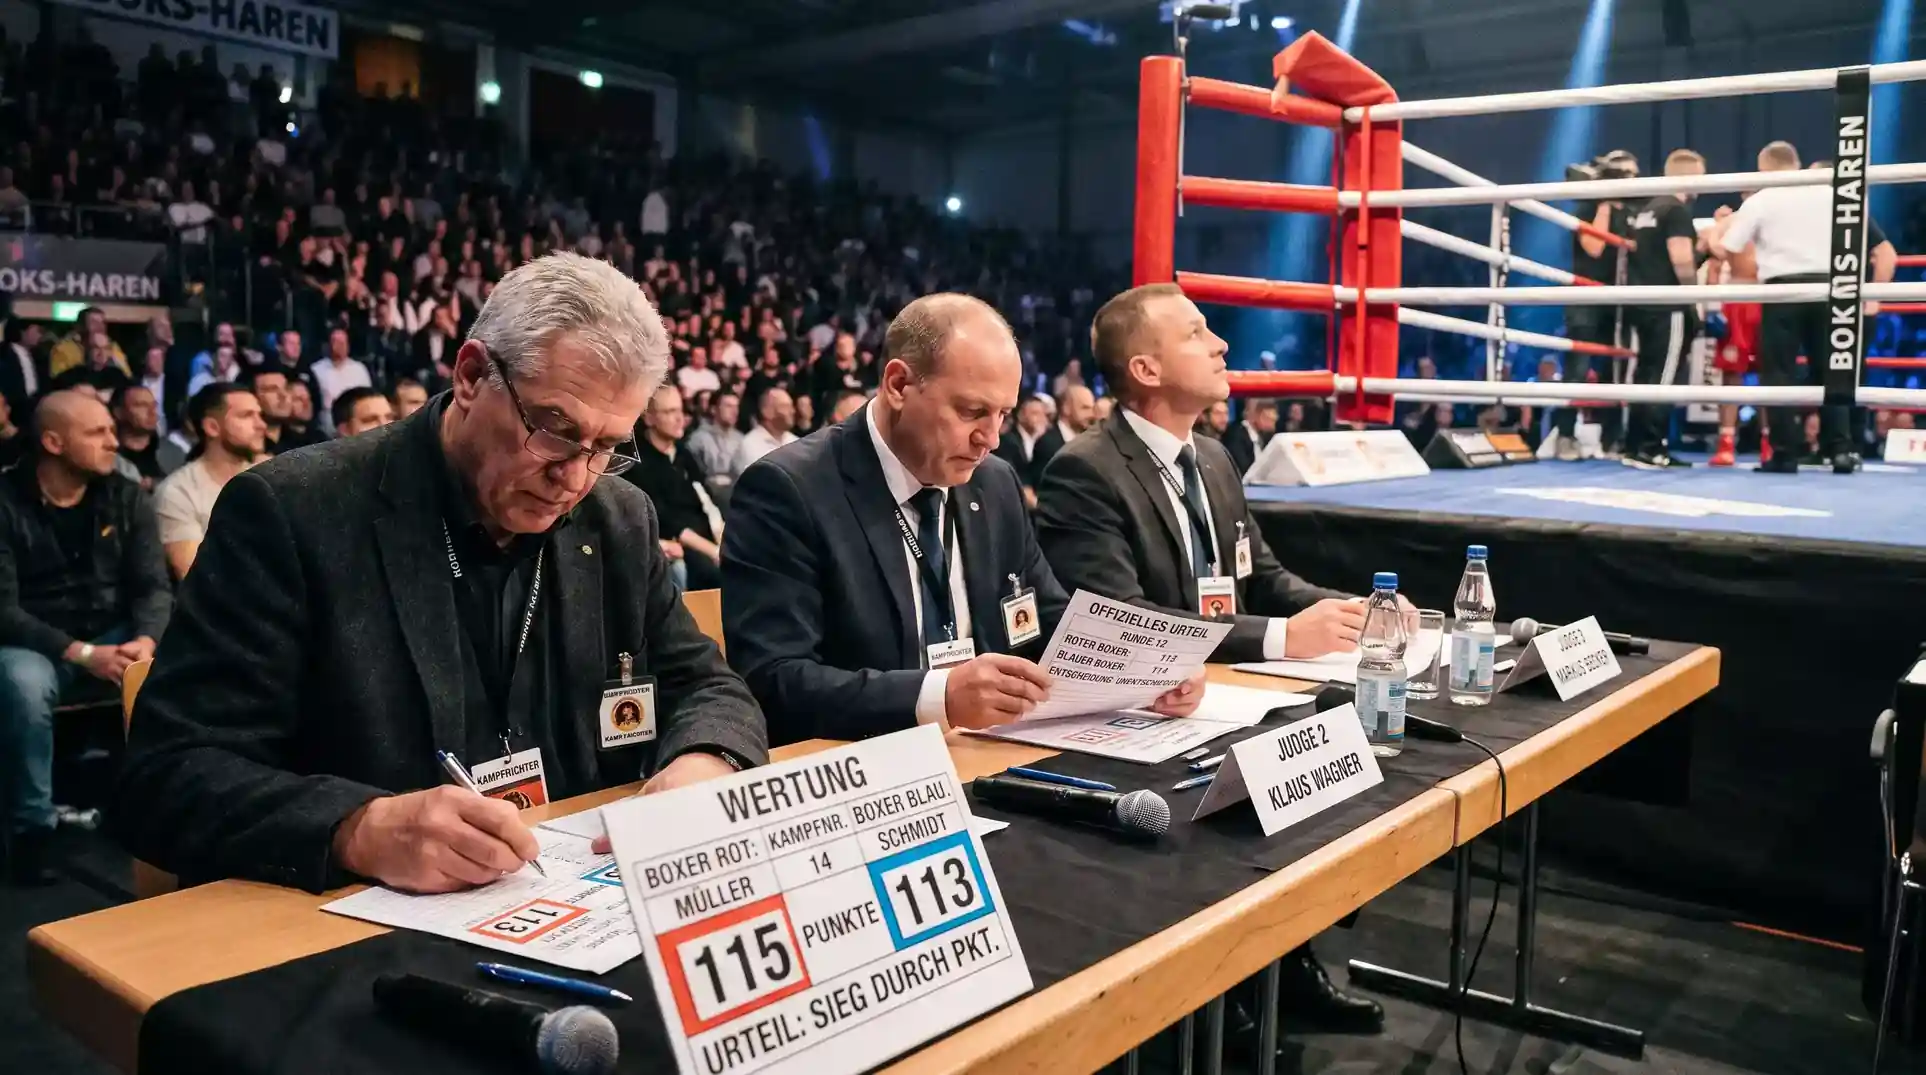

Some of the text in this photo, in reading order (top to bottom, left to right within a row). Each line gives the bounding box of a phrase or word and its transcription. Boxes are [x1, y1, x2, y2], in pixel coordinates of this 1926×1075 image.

[1089, 602, 1209, 638] OFFIZIELLES URTEIL
[1056, 649, 1094, 666] BLAUER
[1064, 634, 1131, 657] ROTER BOXER:
[1155, 639, 1168, 648] 12
[1277, 723, 1330, 762] JUDGE 2
[476, 760, 540, 785] KAMPFRICHTER
[716, 756, 868, 824] WERTUNG
[1267, 752, 1364, 811] KLAUS WAGNER
[852, 780, 951, 825] BOXER BLAU.
[768, 813, 848, 851] KAMPFNR.
[877, 813, 948, 852] SCHMIDT
[644, 839, 759, 889] BOXER ROT:
[809, 851, 833, 875] 14
[674, 876, 755, 920] MÜLLER
[895, 857, 975, 926] 113
[802, 901, 881, 949] PUNKTE
[694, 922, 793, 1004] 115
[702, 927, 1000, 1075] URTEIL: SIEG DURCH PKT.
